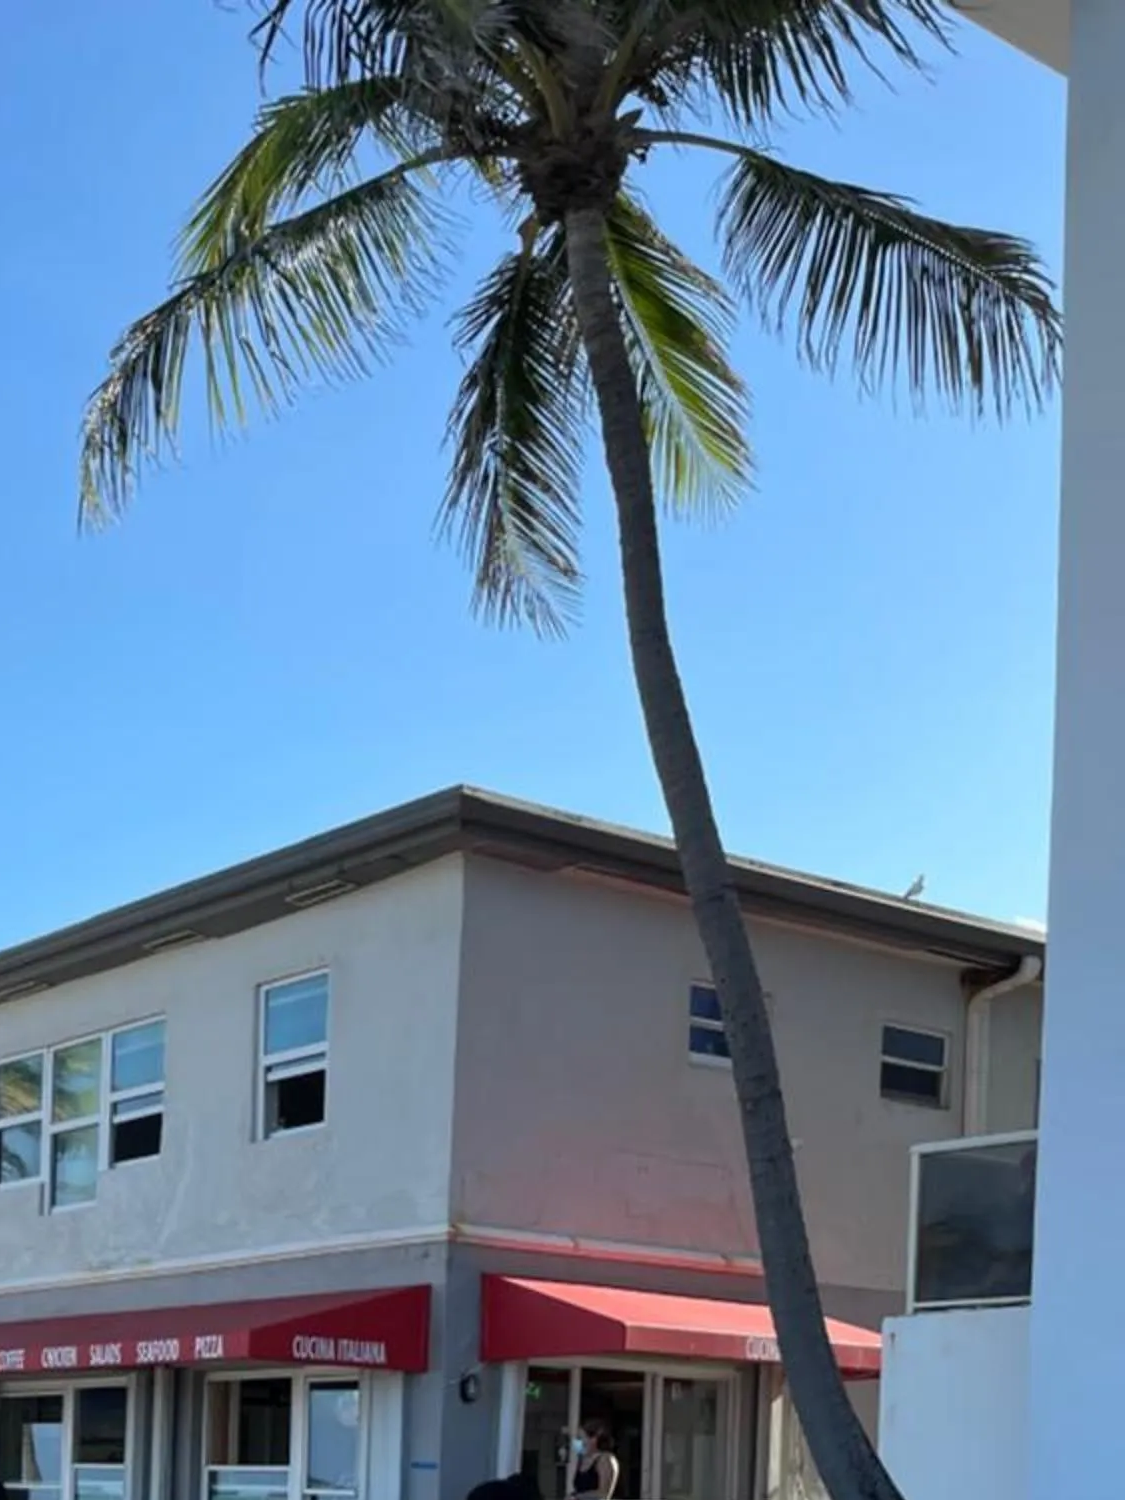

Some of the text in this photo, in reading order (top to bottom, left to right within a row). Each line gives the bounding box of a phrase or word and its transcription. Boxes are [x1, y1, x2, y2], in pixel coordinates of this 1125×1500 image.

[41, 1346, 77, 1368] CHICKEN
[90, 1343, 122, 1366] SALADS
[136, 1338, 179, 1364] SEAFOOD
[194, 1335, 224, 1359] PIZZA
[292, 1334, 387, 1364] CUCINA ITALIANA
